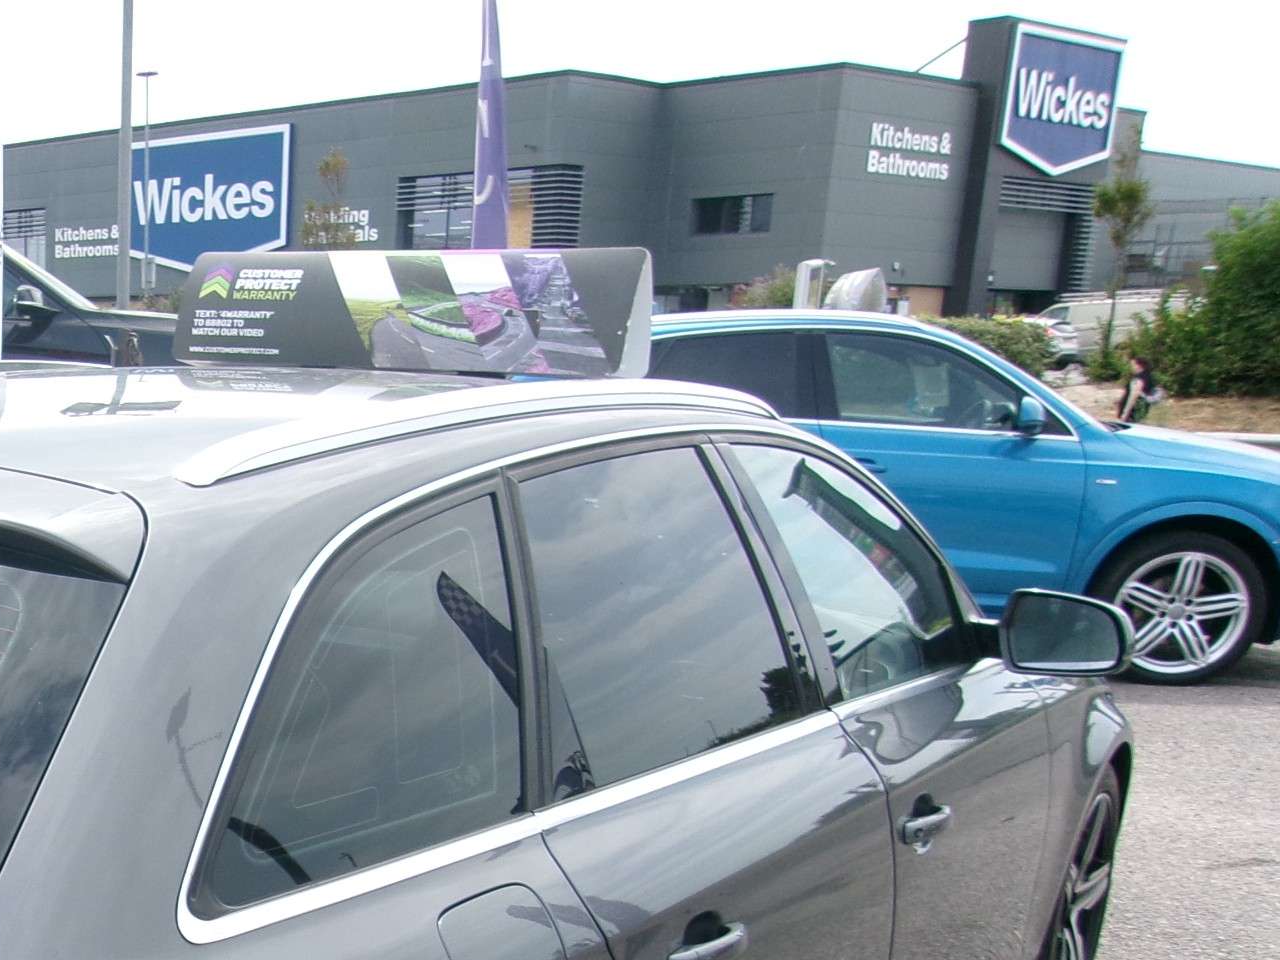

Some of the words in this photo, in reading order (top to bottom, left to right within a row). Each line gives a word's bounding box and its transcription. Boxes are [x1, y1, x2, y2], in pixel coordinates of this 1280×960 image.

[1017, 67, 1110, 130] Wickes
[870, 122, 939, 151] Kitchens
[939, 131, 952, 155] &
[867, 150, 950, 181] Bathrooms
[133, 173, 275, 226] Wickes
[54, 227, 109, 242] Kitchens
[110, 226, 120, 240] &
[54, 244, 120, 259] Bathrooms
[239, 269, 304, 279] CUSTOMER
[235, 279, 301, 290] PROTECT
[232, 290, 297, 300] WARRANTY
[193, 318, 205, 327] TO
[233, 319, 245, 328] TO
[192, 327, 220, 336] WATCH
[220, 328, 239, 337] OUR
[239, 328, 265, 337] VIDEO
